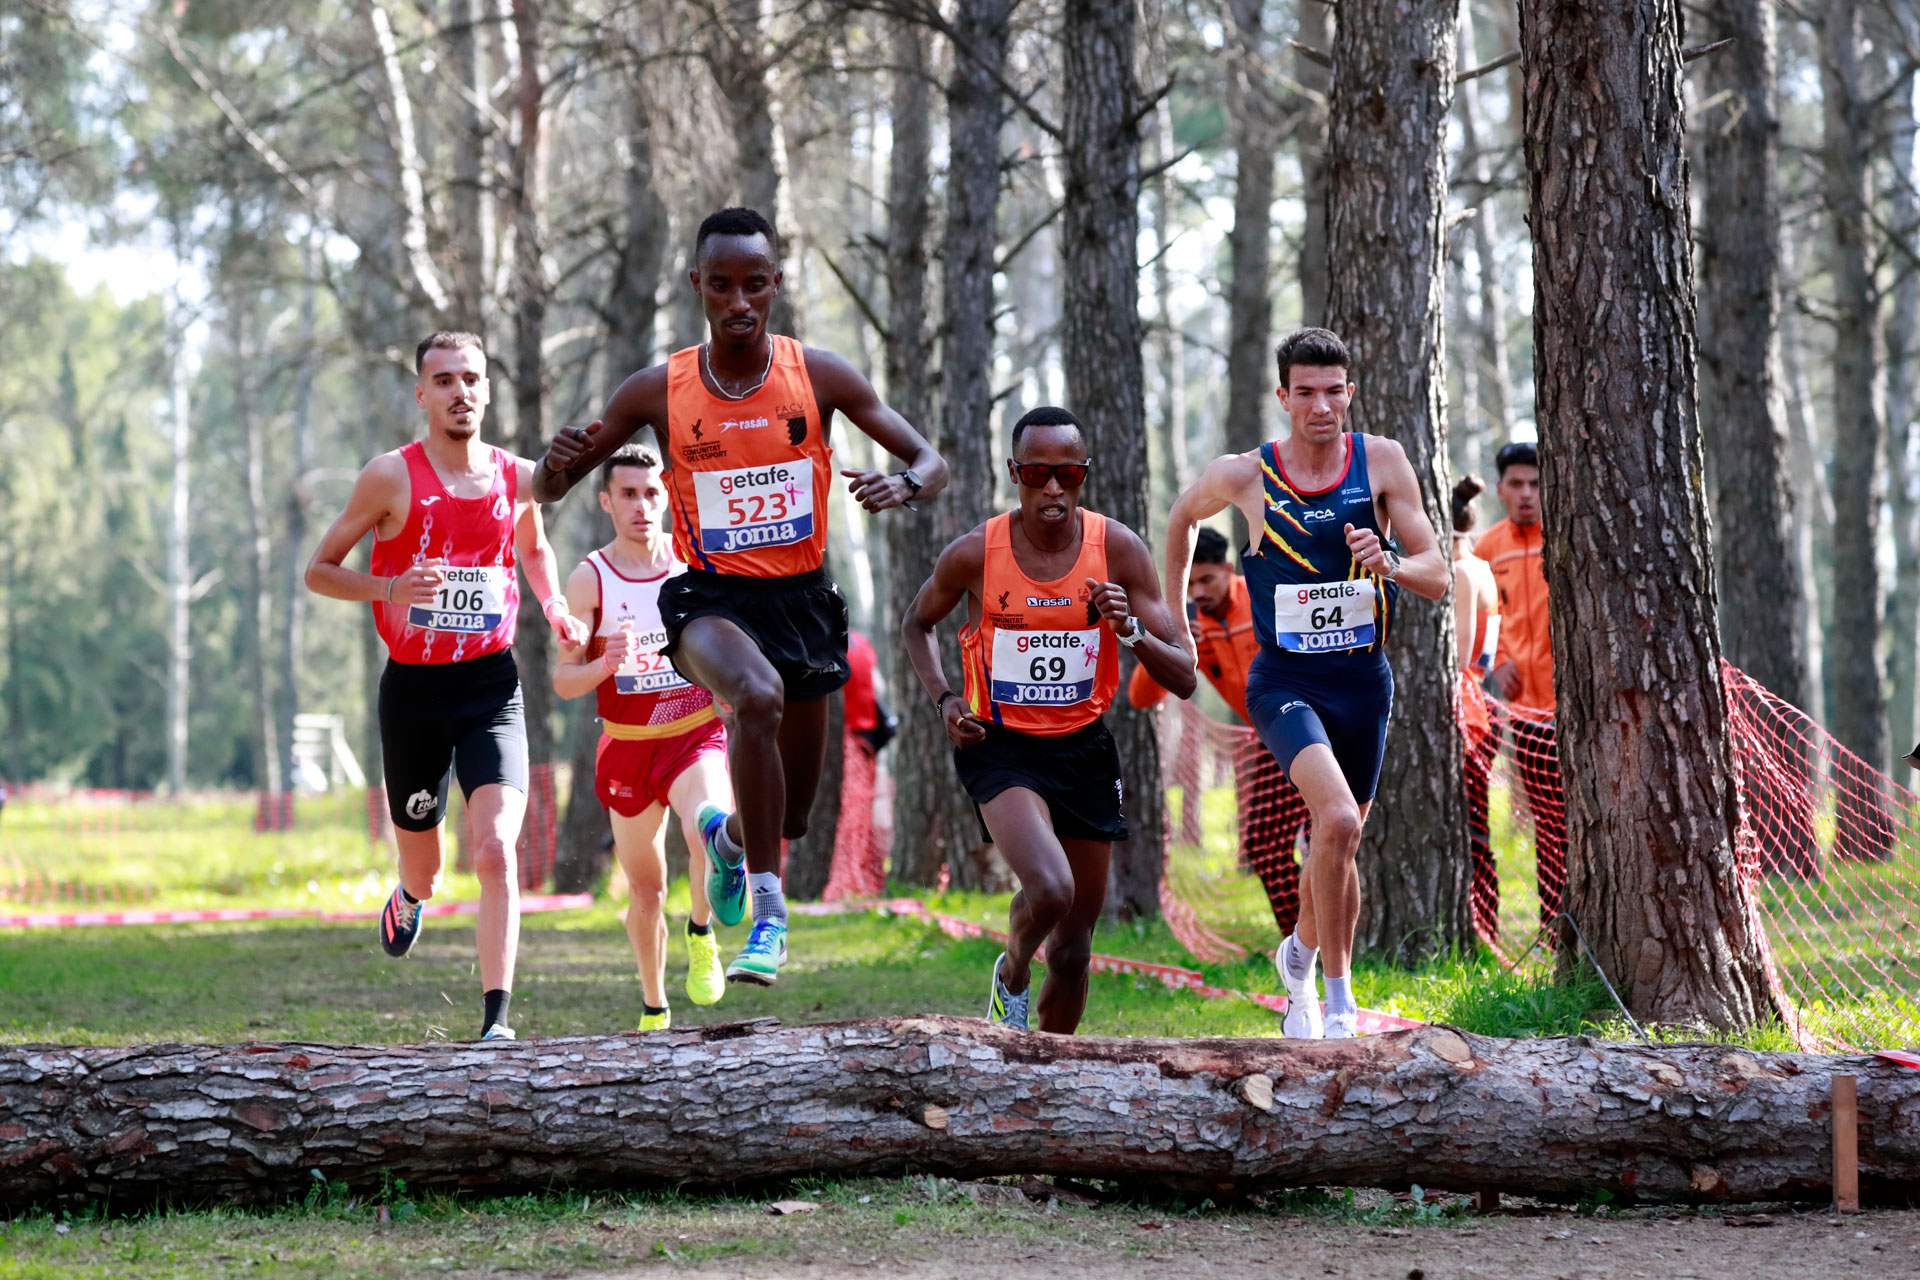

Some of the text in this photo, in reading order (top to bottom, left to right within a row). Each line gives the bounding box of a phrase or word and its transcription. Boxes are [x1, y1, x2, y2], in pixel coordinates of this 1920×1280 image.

[776, 402, 803, 414] FACV
[739, 416, 769, 430] rasán
[682, 445, 721, 456] COMUNITAT
[728, 493, 788, 526] 523
[1303, 509, 1336, 520] FCA
[439, 588, 483, 611] 106
[1038, 596, 1071, 606] rasán
[1311, 606, 1344, 630] 64
[1029, 656, 1066, 681] 69
